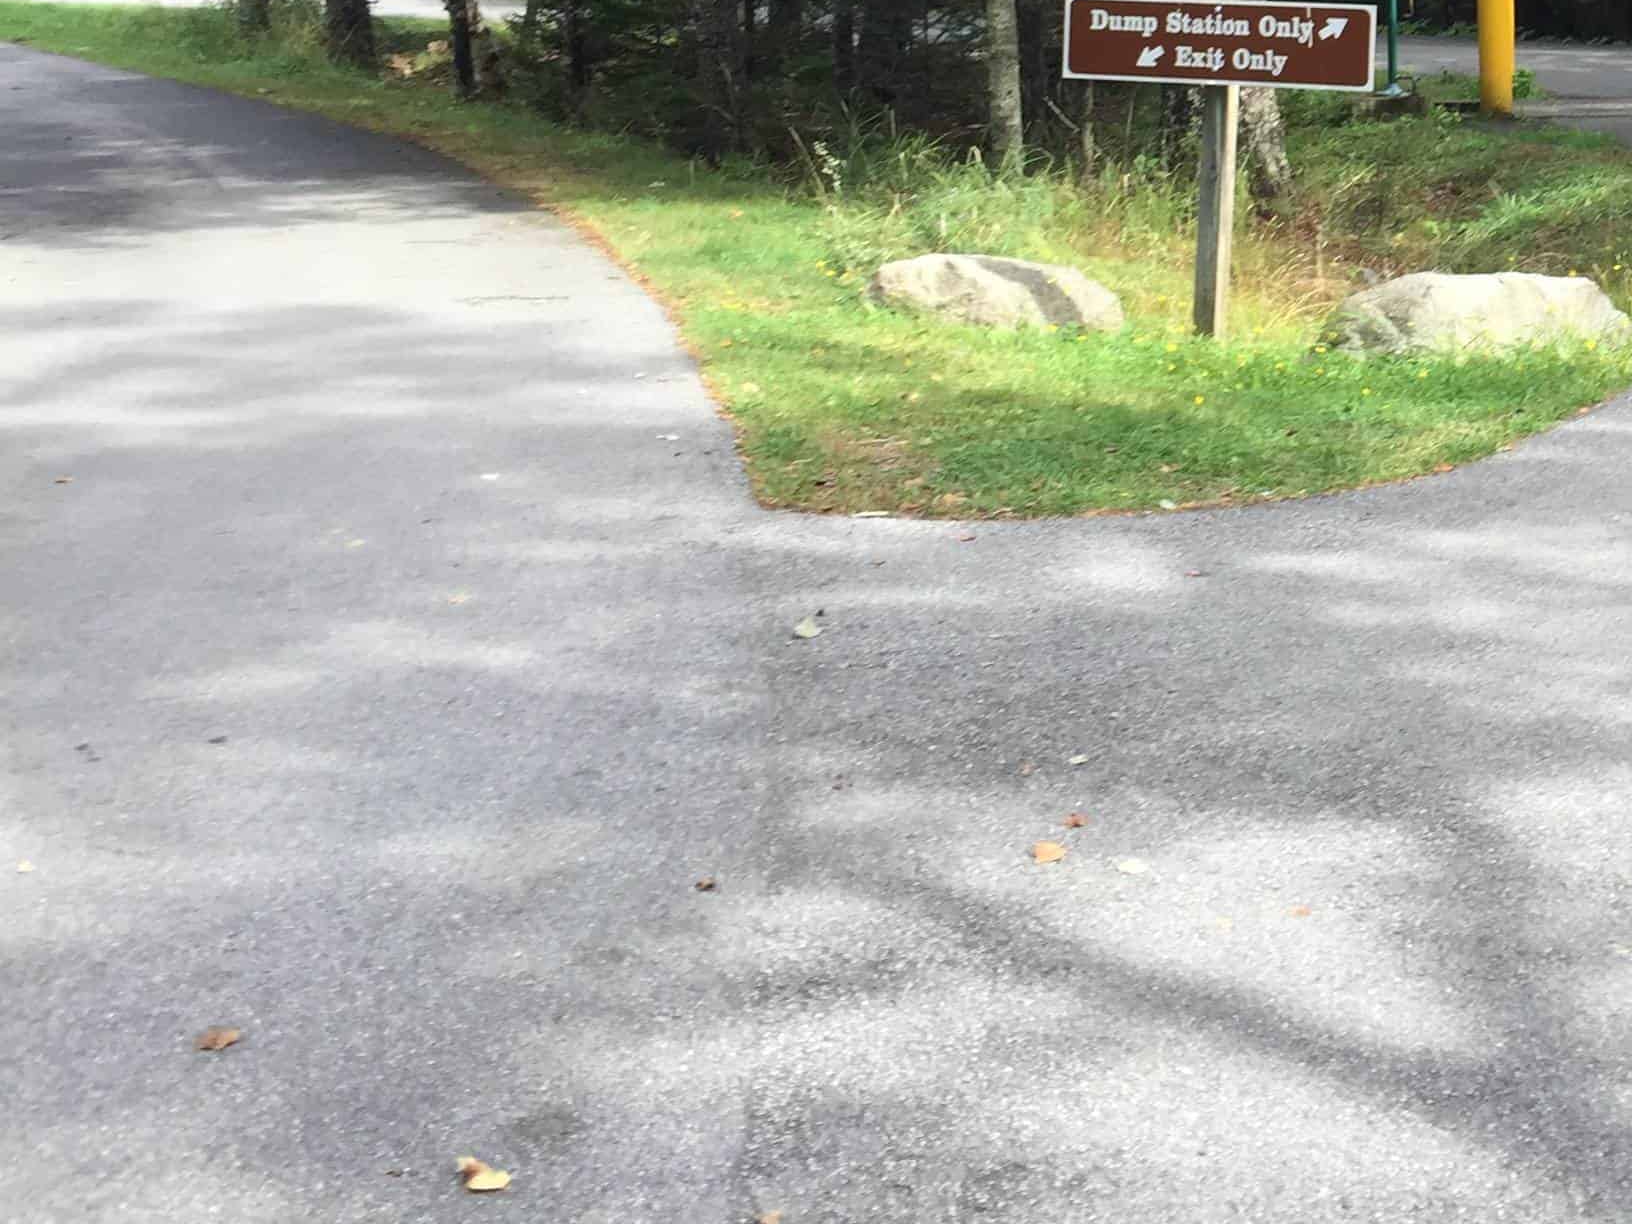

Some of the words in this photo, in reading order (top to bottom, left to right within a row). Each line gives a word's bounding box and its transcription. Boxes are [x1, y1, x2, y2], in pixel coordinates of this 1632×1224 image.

[1090, 9, 1157, 36] Dump
[1166, 10, 1249, 36] Station
[1259, 16, 1313, 43] Only
[1174, 45, 1224, 69] Exit
[1233, 49, 1288, 75] Only
